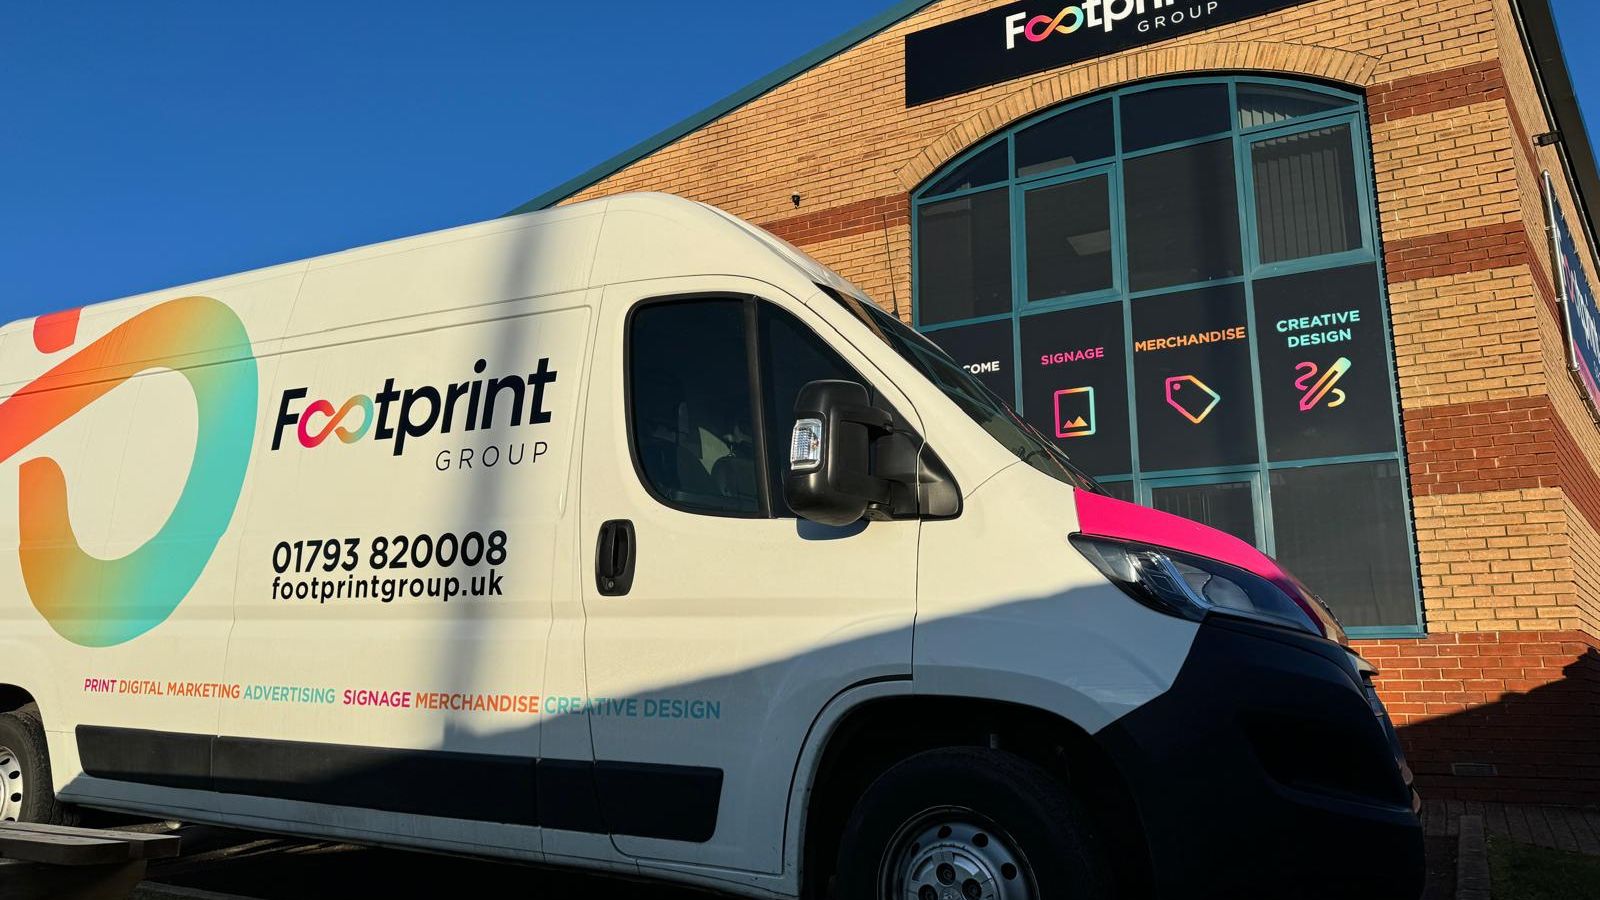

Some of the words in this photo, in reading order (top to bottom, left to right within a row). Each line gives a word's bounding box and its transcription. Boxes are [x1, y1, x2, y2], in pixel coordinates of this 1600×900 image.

[1137, 1, 1218, 33] GROUP
[1275, 309, 1361, 333] CREATIVE
[1134, 326, 1247, 352] MERCHANDISE
[1287, 328, 1352, 348] DESIGN
[1040, 346, 1105, 366] SIGNAGE
[271, 357, 558, 457] Footprint
[435, 441, 548, 471] GROUP
[272, 537, 361, 574] 01793
[369, 530, 508, 568] 820008
[271, 569, 504, 604] footprintgroup.uk
[84, 678, 117, 693] PRINT
[119, 680, 164, 695] DIGITAL
[167, 682, 241, 699] MARKETING
[243, 685, 336, 704] ADVERTISING
[342, 689, 411, 708] SIGNAGE
[415, 693, 539, 713] MERCHANDISE
[544, 696, 637, 716] CREATIVE
[643, 698, 721, 720] DESIGN
